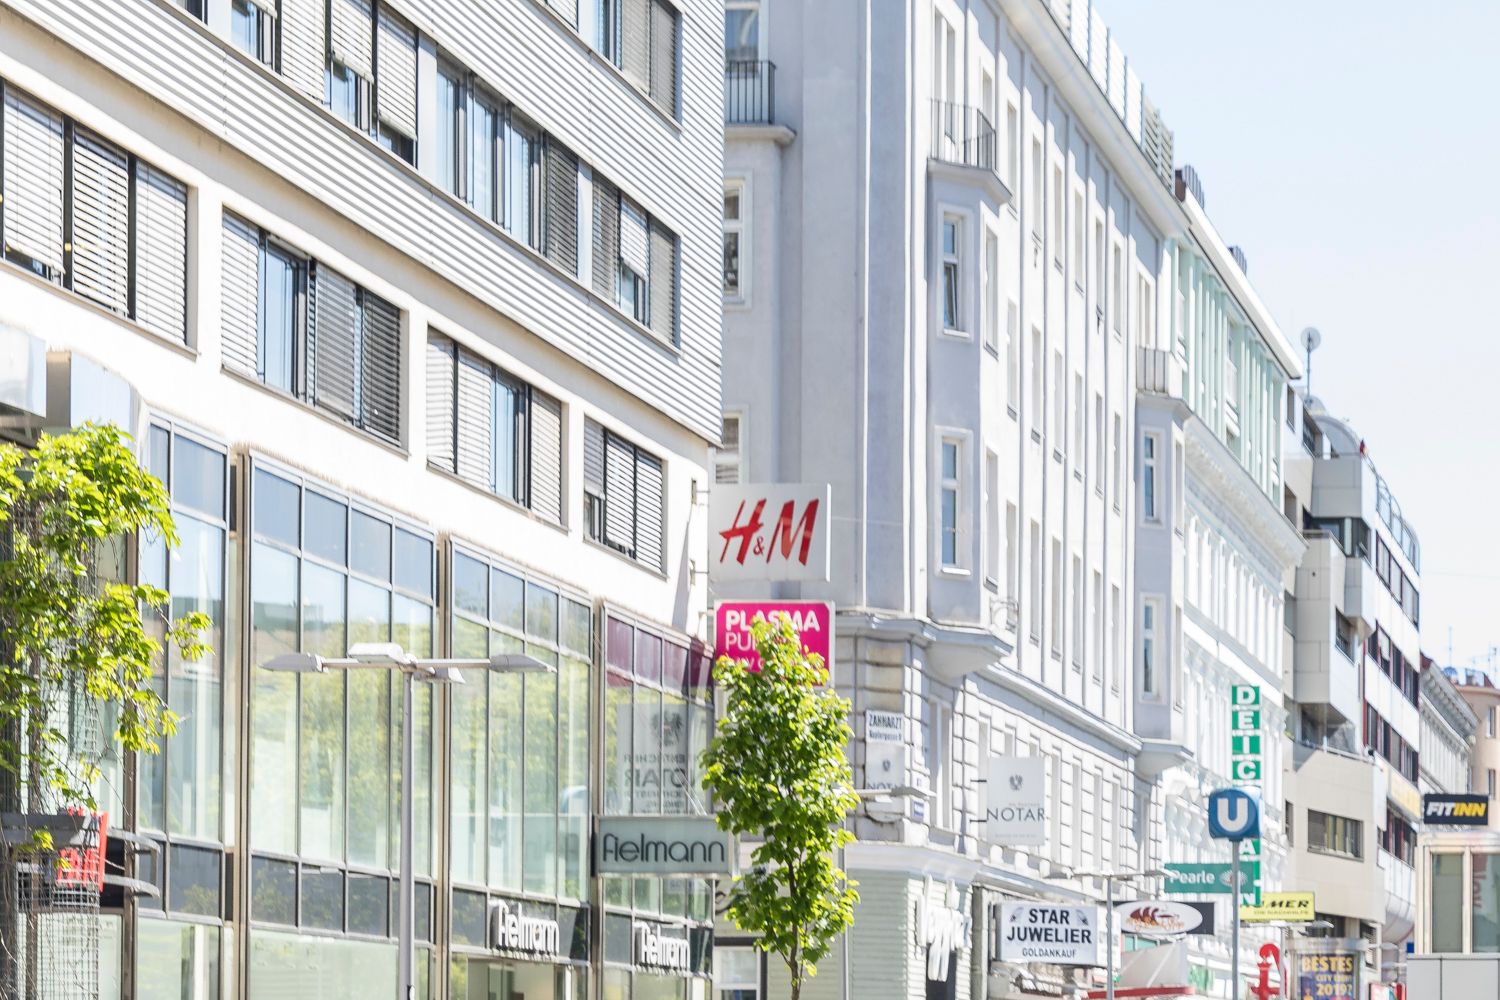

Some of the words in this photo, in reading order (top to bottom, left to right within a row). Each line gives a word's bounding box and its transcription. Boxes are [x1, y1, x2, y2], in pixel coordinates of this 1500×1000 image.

[719, 498, 819, 566] H&M
[725, 631, 758, 651] PU
[986, 807, 1045, 821] NOTAR
[1217, 798, 1249, 833] U
[1426, 802, 1487, 817] FITINN
[603, 833, 725, 863] fielmann
[1170, 870, 1215, 884] Pearle
[1028, 908, 1070, 925] STAR
[1007, 926, 1092, 944] JUWELIER
[1022, 947, 1077, 958] GOLDANKAUF
[1302, 956, 1353, 973] BESTES
[1316, 984, 1353, 996] 2019?
